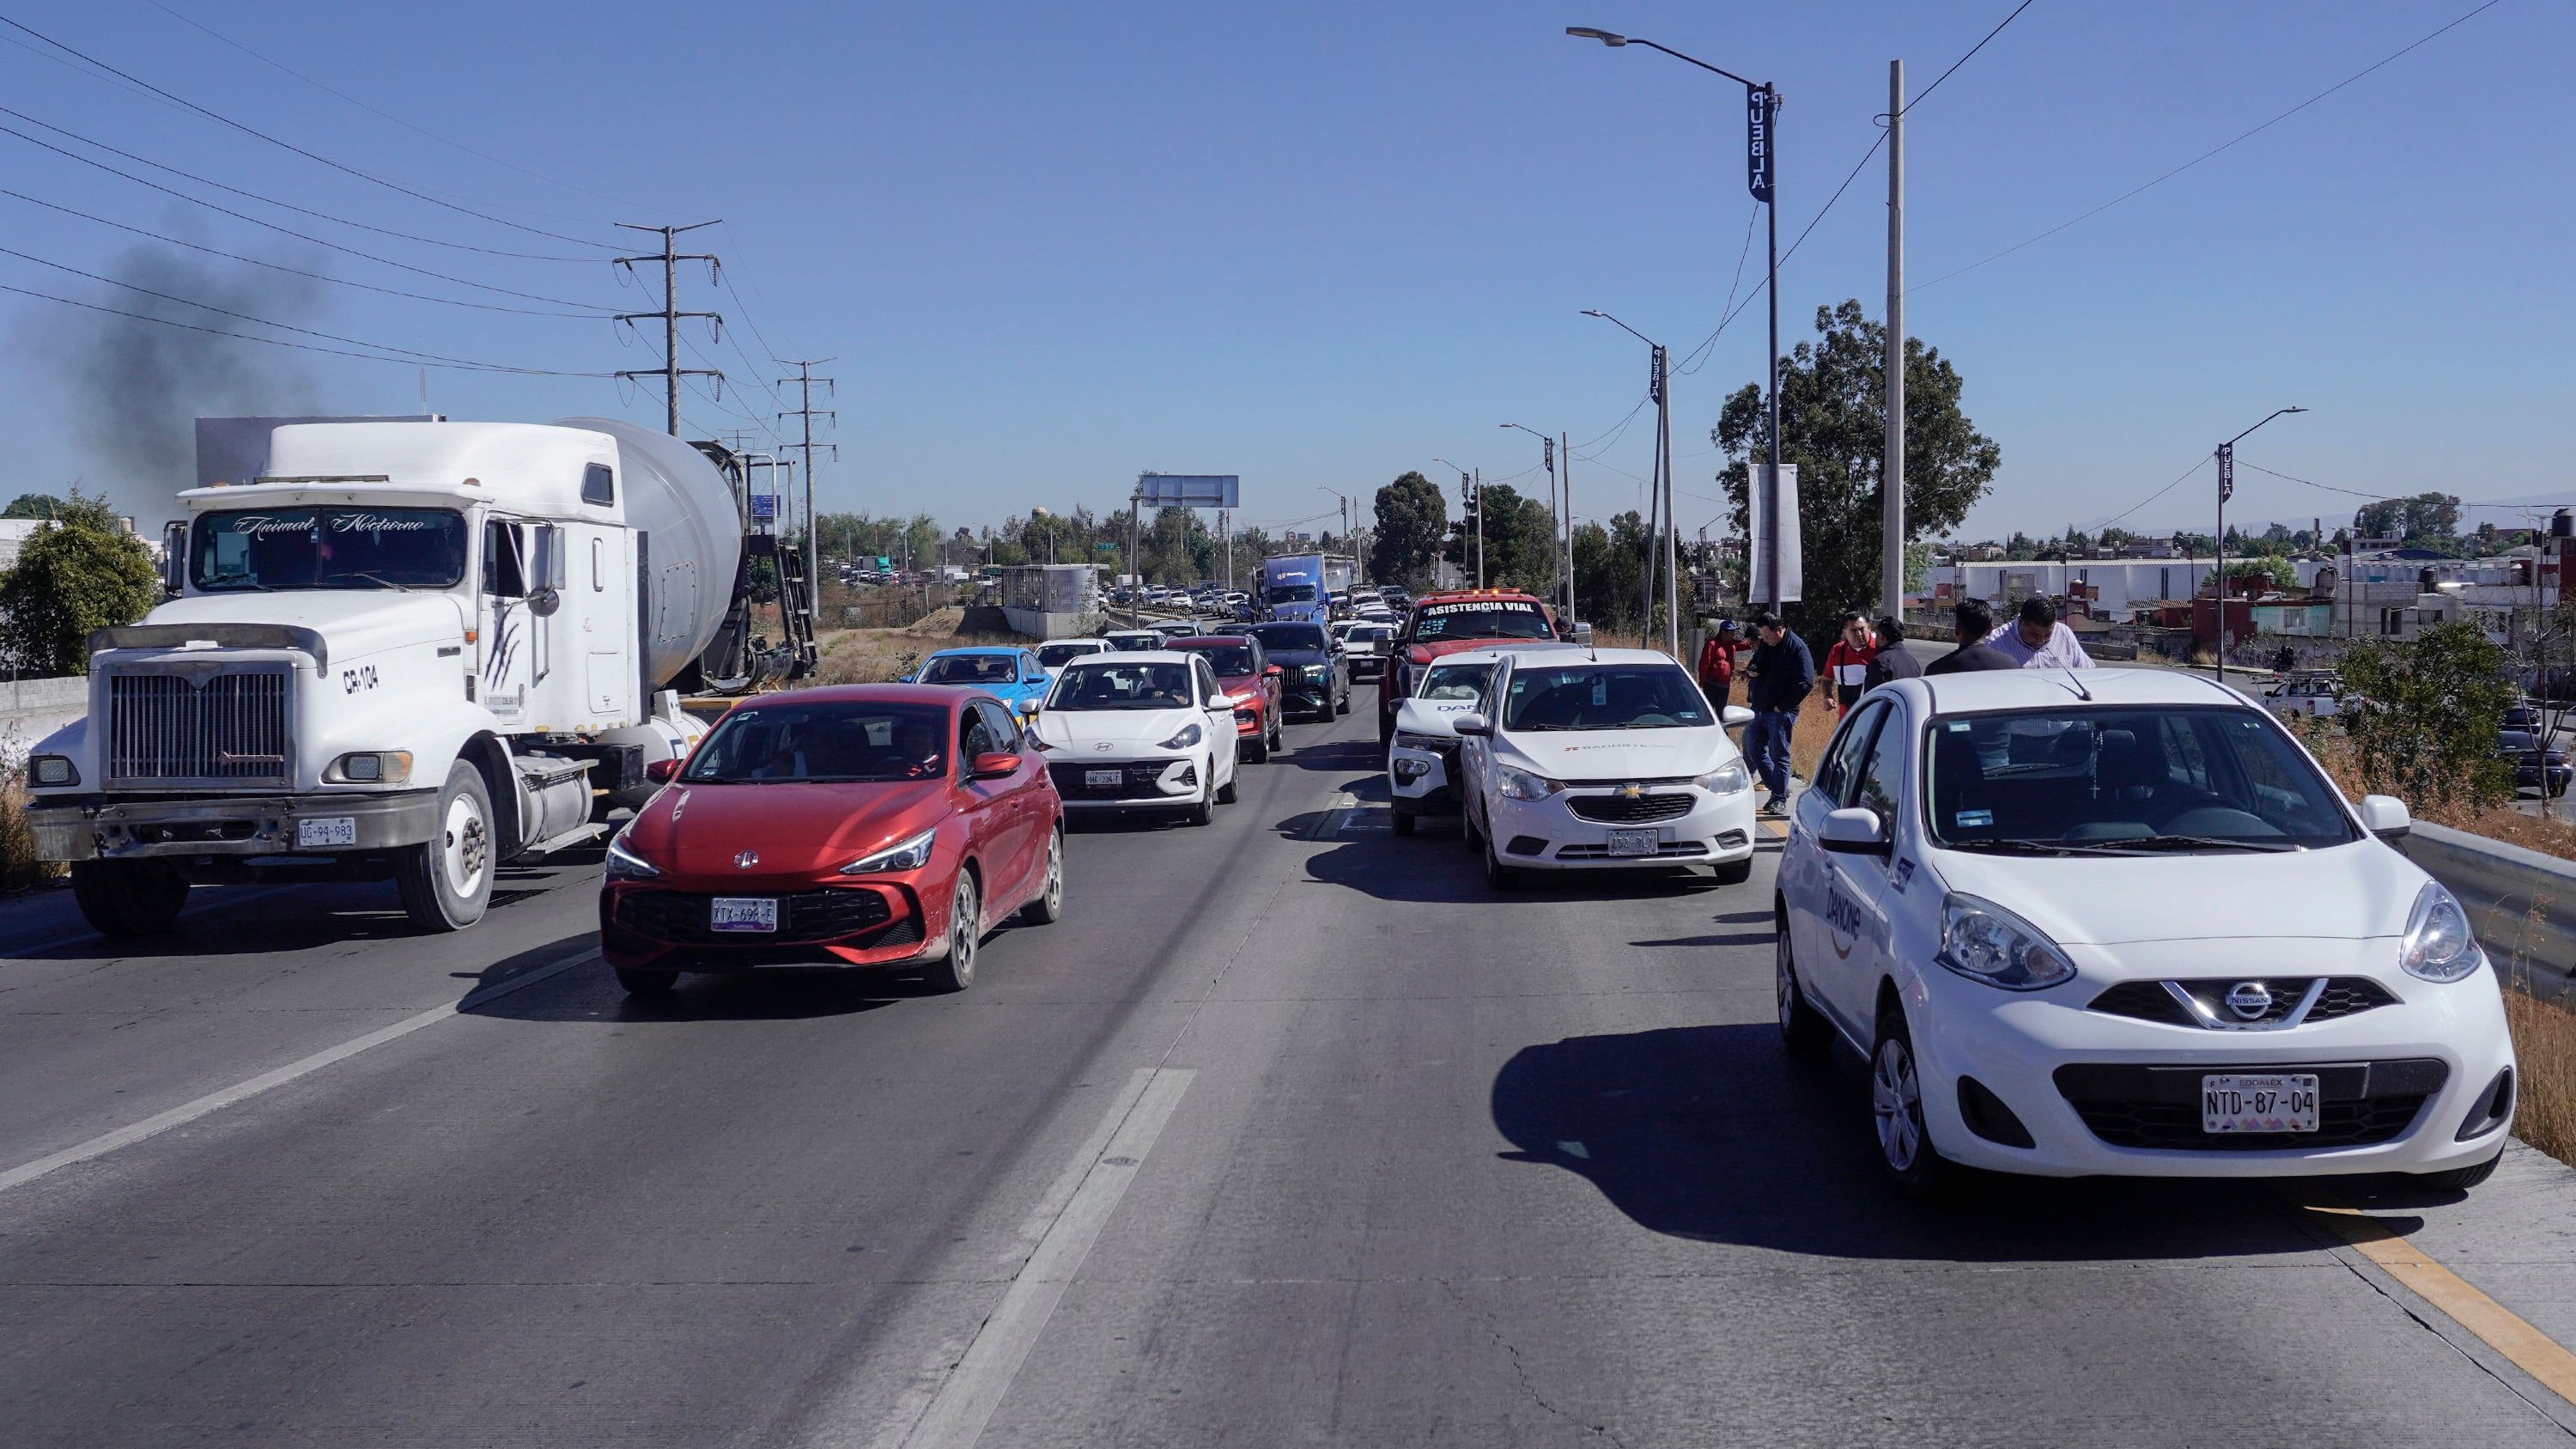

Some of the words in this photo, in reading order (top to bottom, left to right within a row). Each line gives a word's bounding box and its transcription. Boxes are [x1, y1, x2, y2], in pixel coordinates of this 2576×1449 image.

[2223, 447, 2232, 496] PUEBLA
[233, 516, 315, 541] Animal
[330, 514, 424, 533] Nocturno
[1427, 601, 1504, 616] ASISTENCIA
[1504, 602, 1534, 612] VIAL
[714, 906, 773, 922] XTX-698-E
[2207, 1090, 2314, 1115] NTD-87-04
